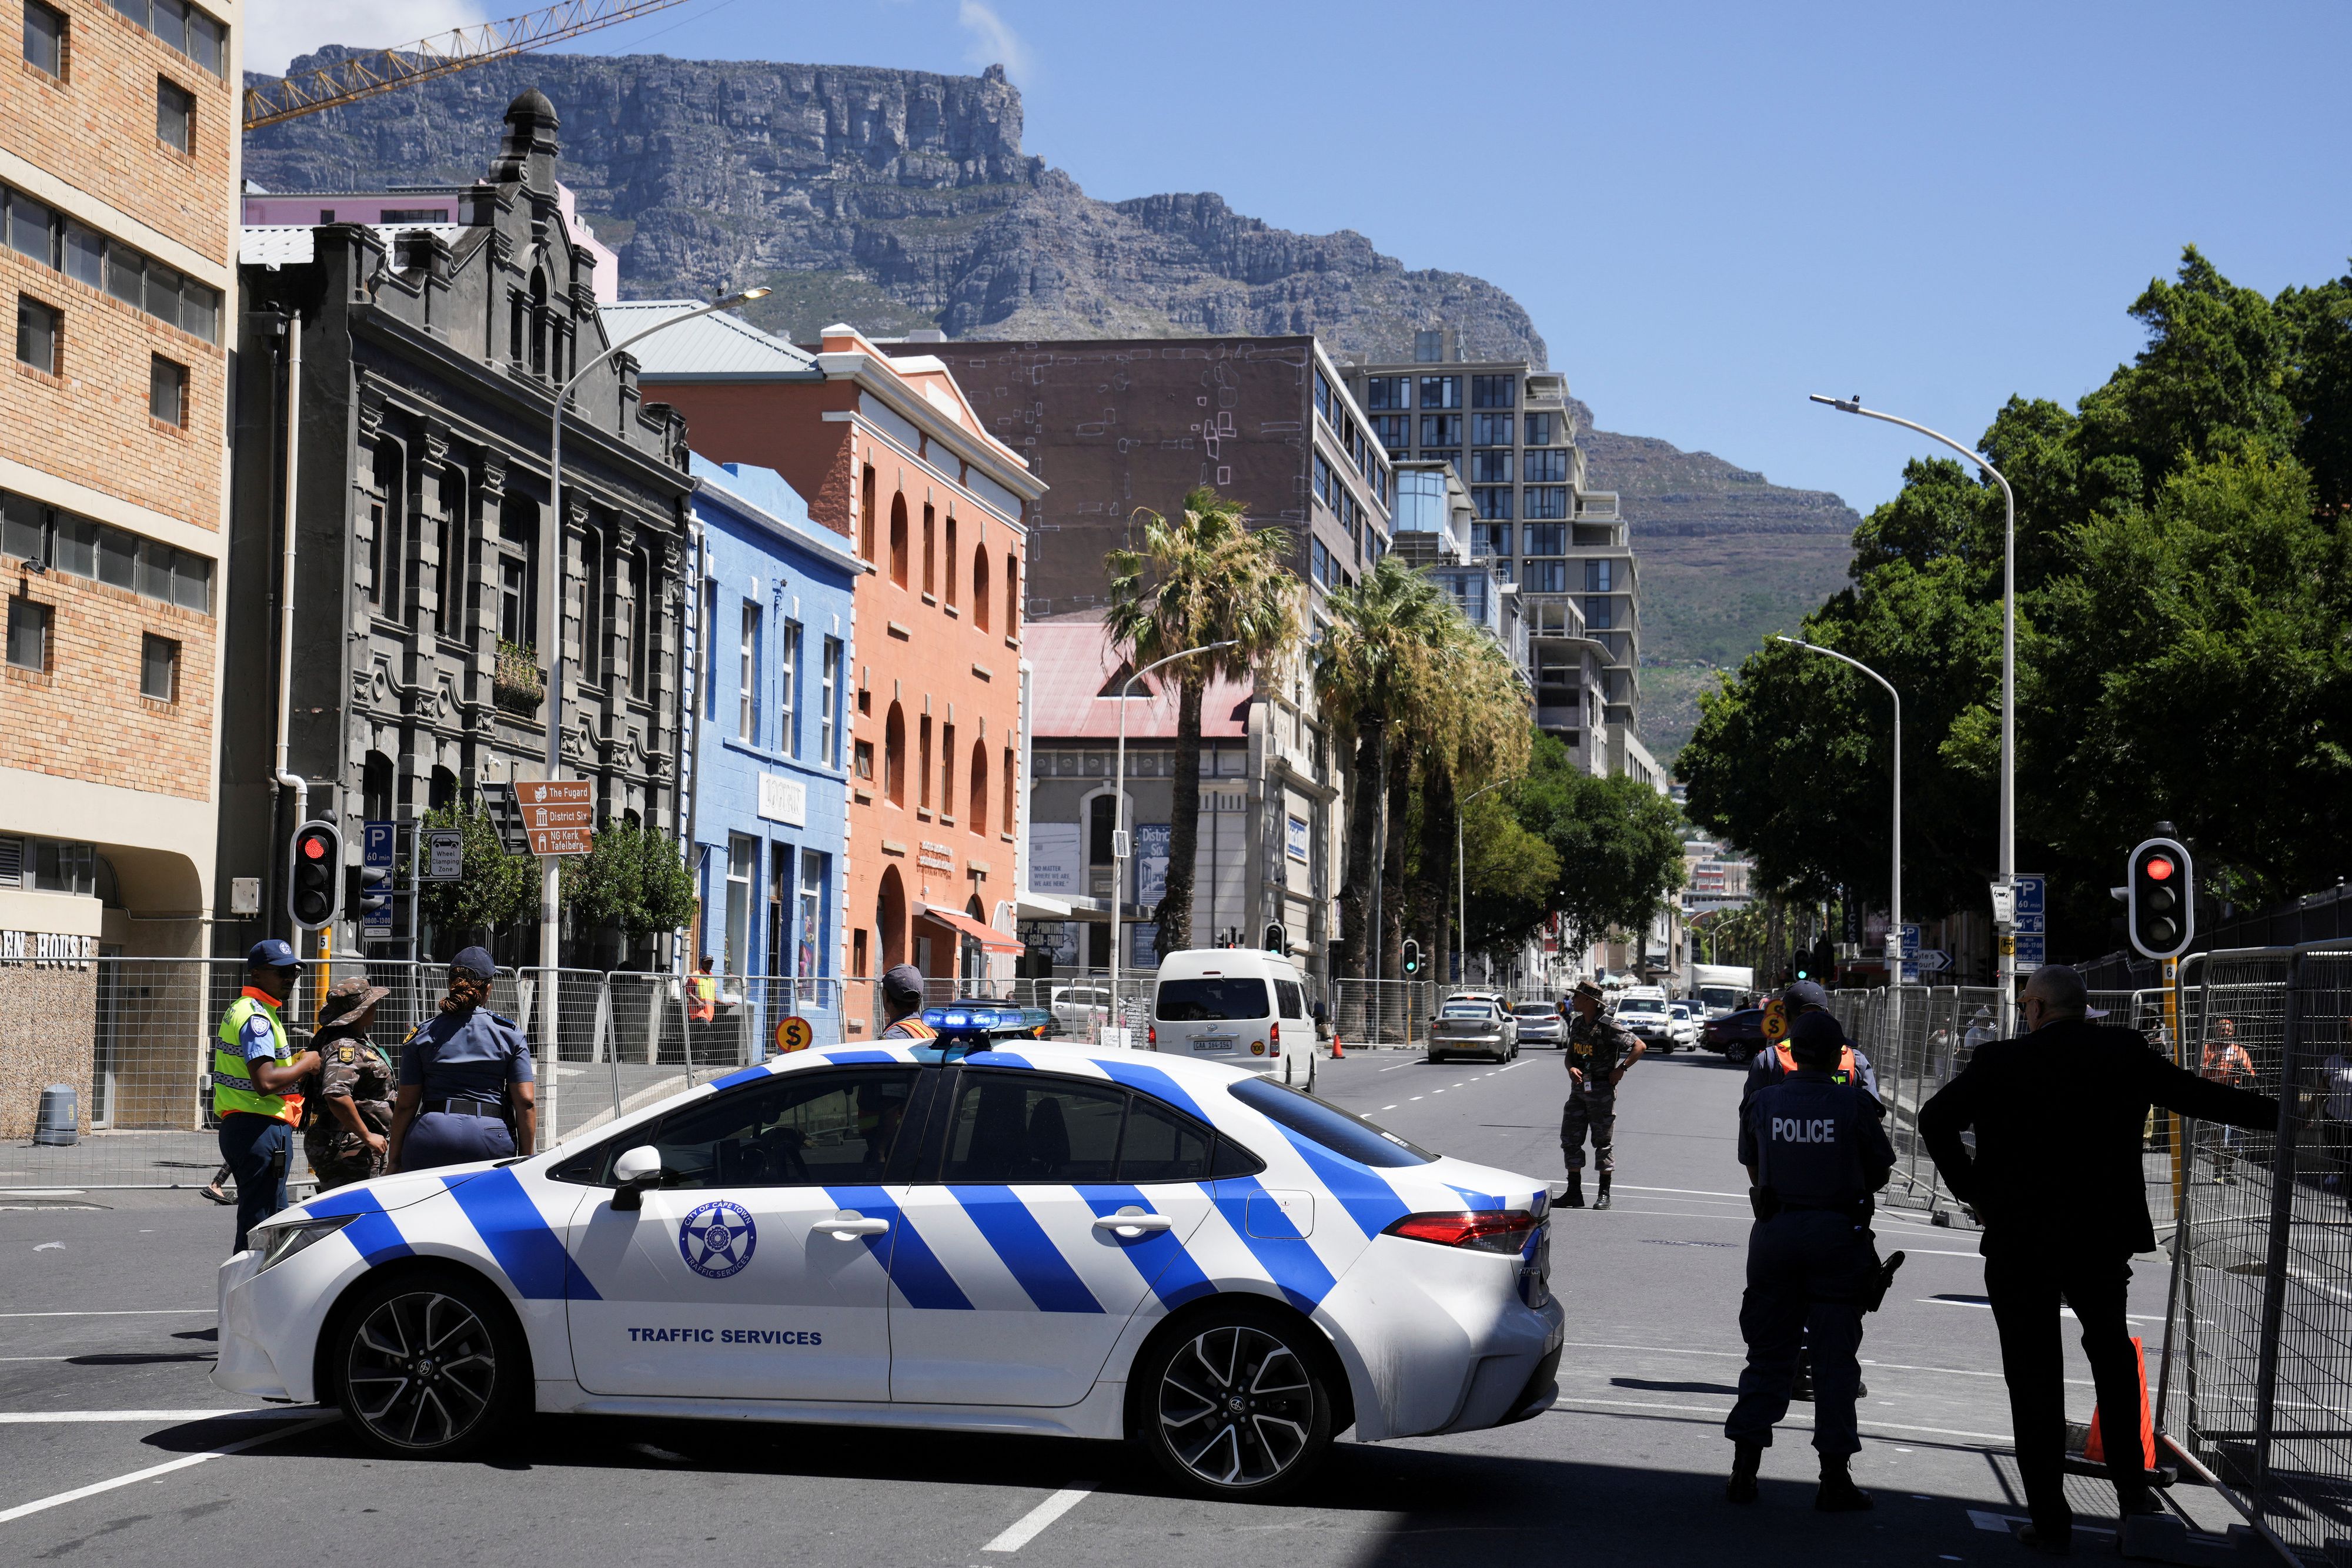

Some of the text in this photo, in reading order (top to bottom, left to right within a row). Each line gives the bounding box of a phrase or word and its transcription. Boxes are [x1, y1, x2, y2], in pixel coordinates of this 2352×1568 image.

[549, 787, 587, 799] The Fugard
[550, 811, 587, 821] District Six
[372, 829, 386, 847] P
[550, 830, 579, 840] NG Kerk
[1142, 828, 1170, 842] Distric
[552, 841, 583, 852] Tafelberg
[1151, 843, 1164, 856] Six
[367, 852, 377, 861] 60
[2023, 881, 2036, 897] P
[2019, 900, 2028, 908] 60
[1037, 922, 1064, 934] PRINTING
[1906, 928, 1915, 937] P
[320, 938, 325, 947] 5
[1028, 934, 1044, 945] SCAN
[1047, 935, 1064, 947] EMAIL
[0, 930, 91, 967] EN HOUSE
[2167, 967, 2173, 978] 6
[1769, 1019, 1779, 1034] S
[786, 1025, 801, 1046] S
[1573, 1042, 1593, 1056] POLICE
[1772, 1117, 1835, 1143] POLICE
[684, 1211, 698, 1226] CITY
[734, 1205, 751, 1224] TOWN
[686, 1255, 749, 1277] TRAFFIC SERVICES
[628, 1328, 822, 1346] TRAFFIC SERVICES
